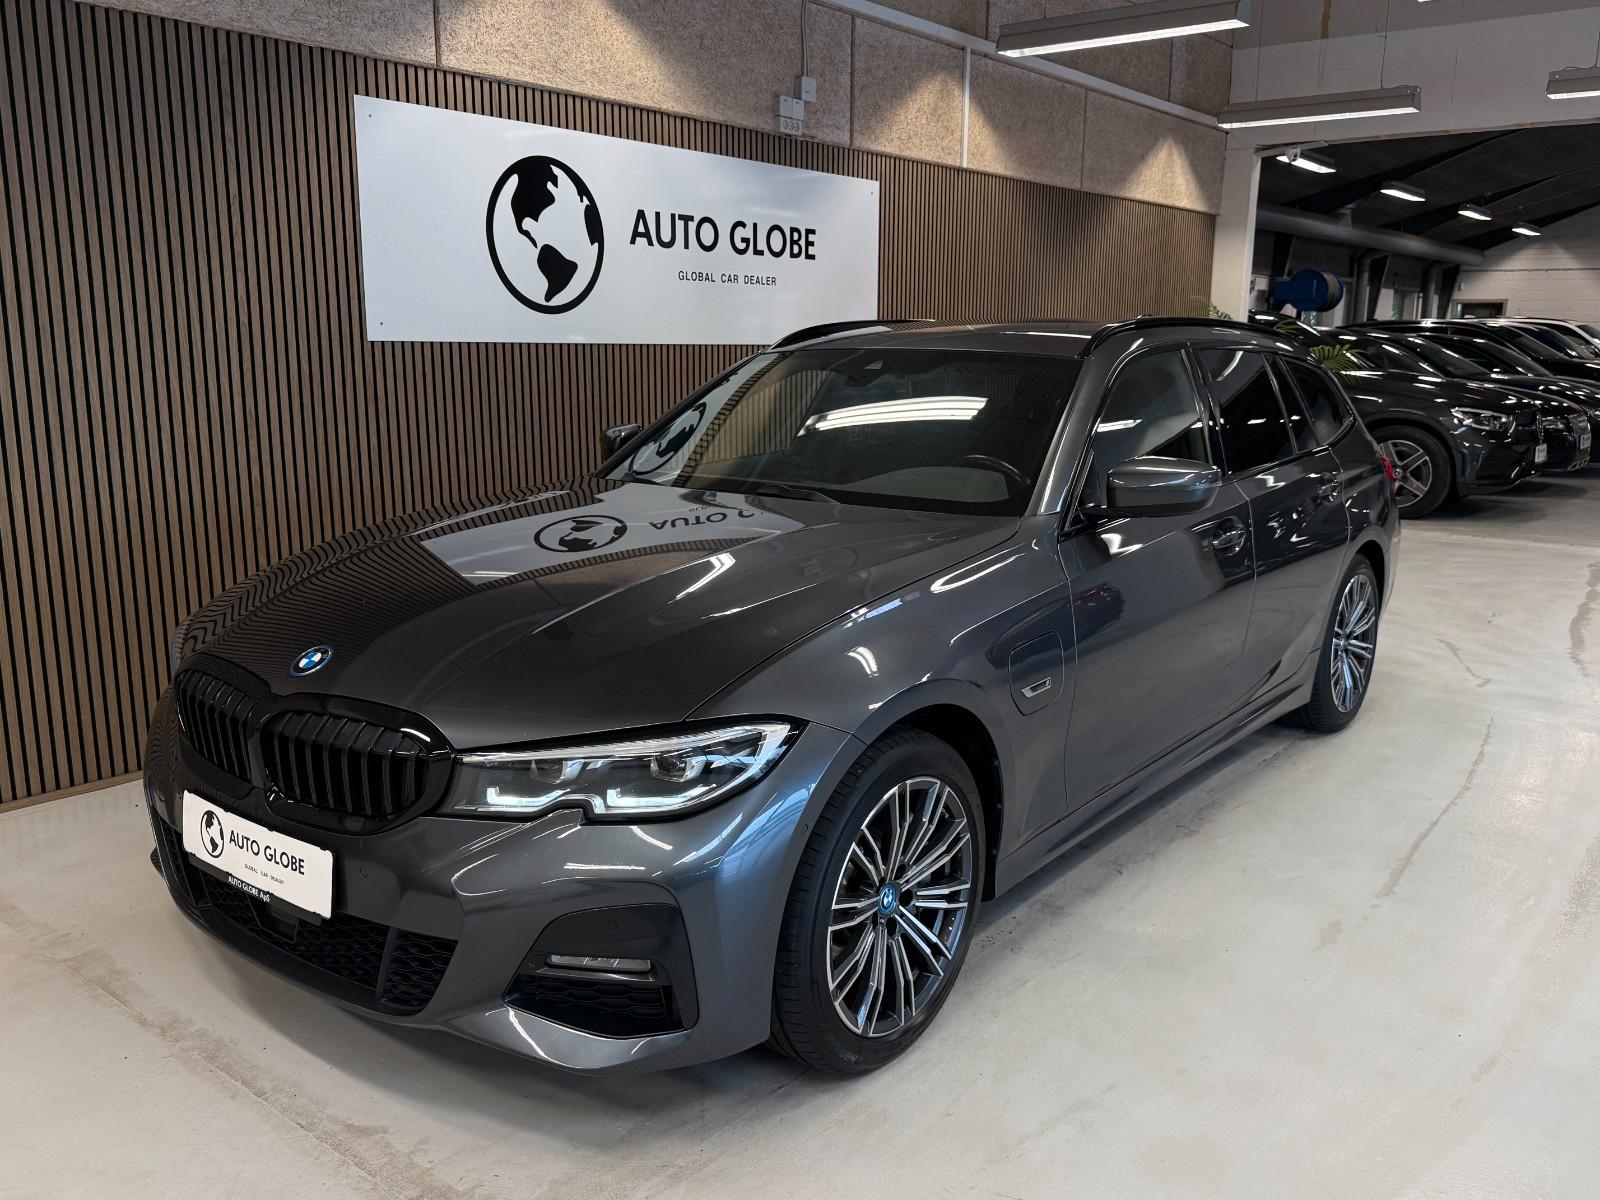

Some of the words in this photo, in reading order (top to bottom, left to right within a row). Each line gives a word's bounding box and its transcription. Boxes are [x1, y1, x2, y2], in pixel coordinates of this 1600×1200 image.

[630, 209, 719, 253] AUTO
[730, 220, 816, 261] GLOBE
[678, 270, 716, 283] GLOBAL
[721, 274, 739, 284] CAR
[744, 275, 777, 286] DEALER
[229, 830, 260, 856] AUTO
[264, 845, 305, 875] GLOBE
[228, 876, 242, 888] AUTO
[242, 883, 258, 896] GLOBE
